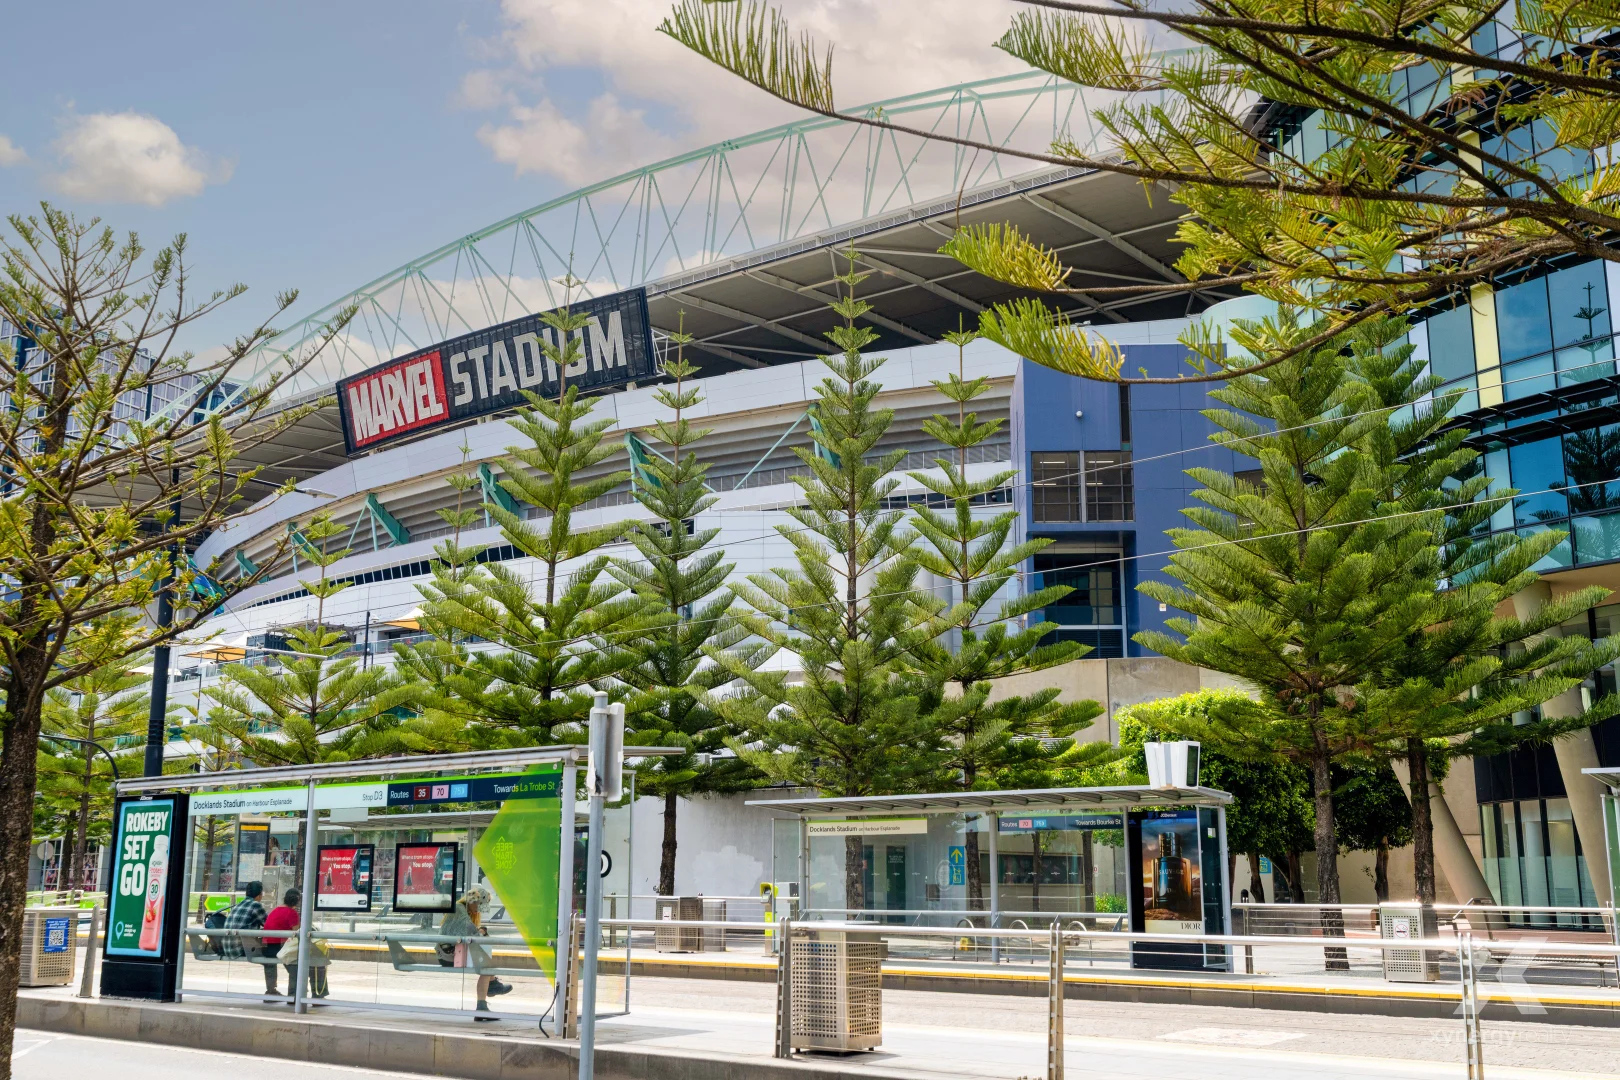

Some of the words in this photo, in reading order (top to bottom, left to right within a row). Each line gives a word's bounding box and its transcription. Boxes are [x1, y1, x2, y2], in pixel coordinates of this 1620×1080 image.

[349, 359, 444, 441] MARVEL
[449, 310, 627, 406] STADIUM
[390, 790, 410, 799] Routes
[417, 788, 427, 798] 35
[436, 787, 445, 797] 70
[493, 783, 519, 793] Towards
[519, 783, 529, 792] La
[529, 781, 547, 791] Trobe
[548, 781, 556, 790] St
[362, 794, 374, 802] Stop
[374, 790, 384, 801] D3
[193, 799, 223, 810] Docklands
[223, 799, 246, 808] Stadium
[269, 798, 293, 807] Esplanade
[126, 811, 169, 832] ROKEBY
[123, 834, 150, 861] SET
[120, 863, 146, 896] GO
[150, 883, 159, 894] 30
[1180, 922, 1201, 930] DIOR
